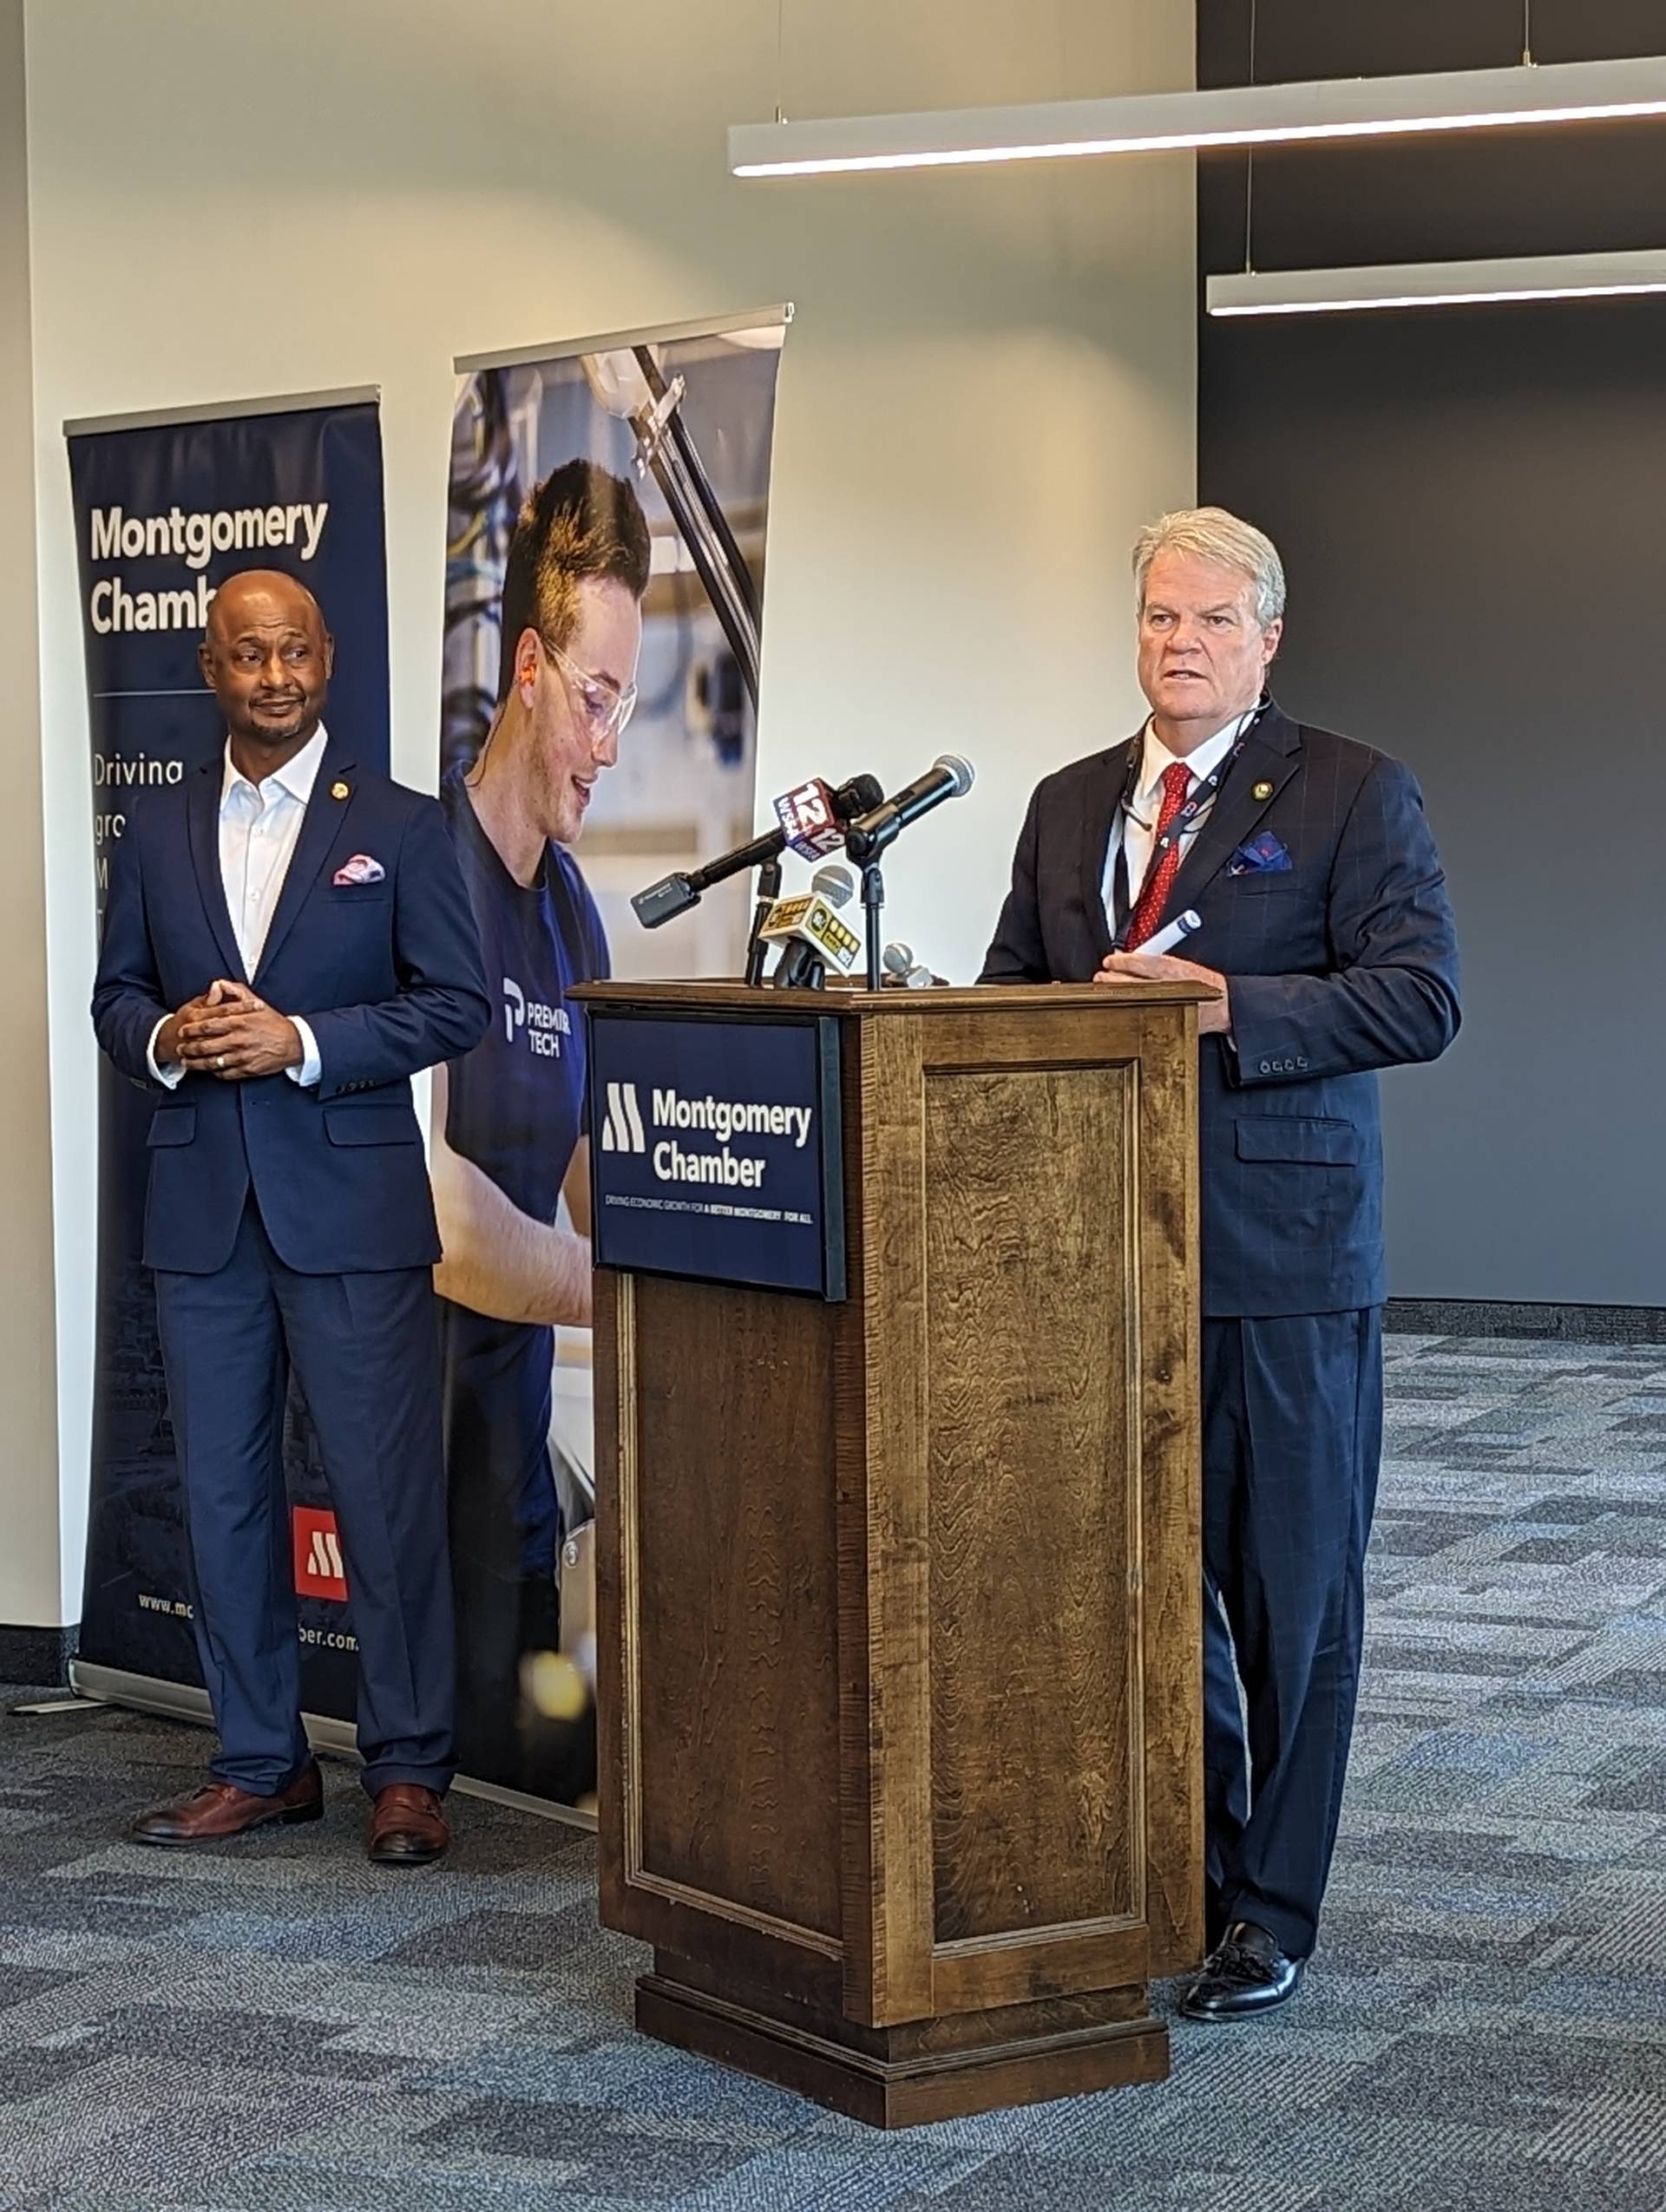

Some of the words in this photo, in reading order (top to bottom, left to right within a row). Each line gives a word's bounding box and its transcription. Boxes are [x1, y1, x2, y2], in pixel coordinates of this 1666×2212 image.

[90, 502, 327, 569] Montgomery
[90, 575, 218, 634] Chamb
[95, 814, 126, 845] gro
[528, 1029, 560, 1057] TECH
[653, 1089, 812, 1148] Montgomery
[653, 1140, 766, 1188] Chamber
